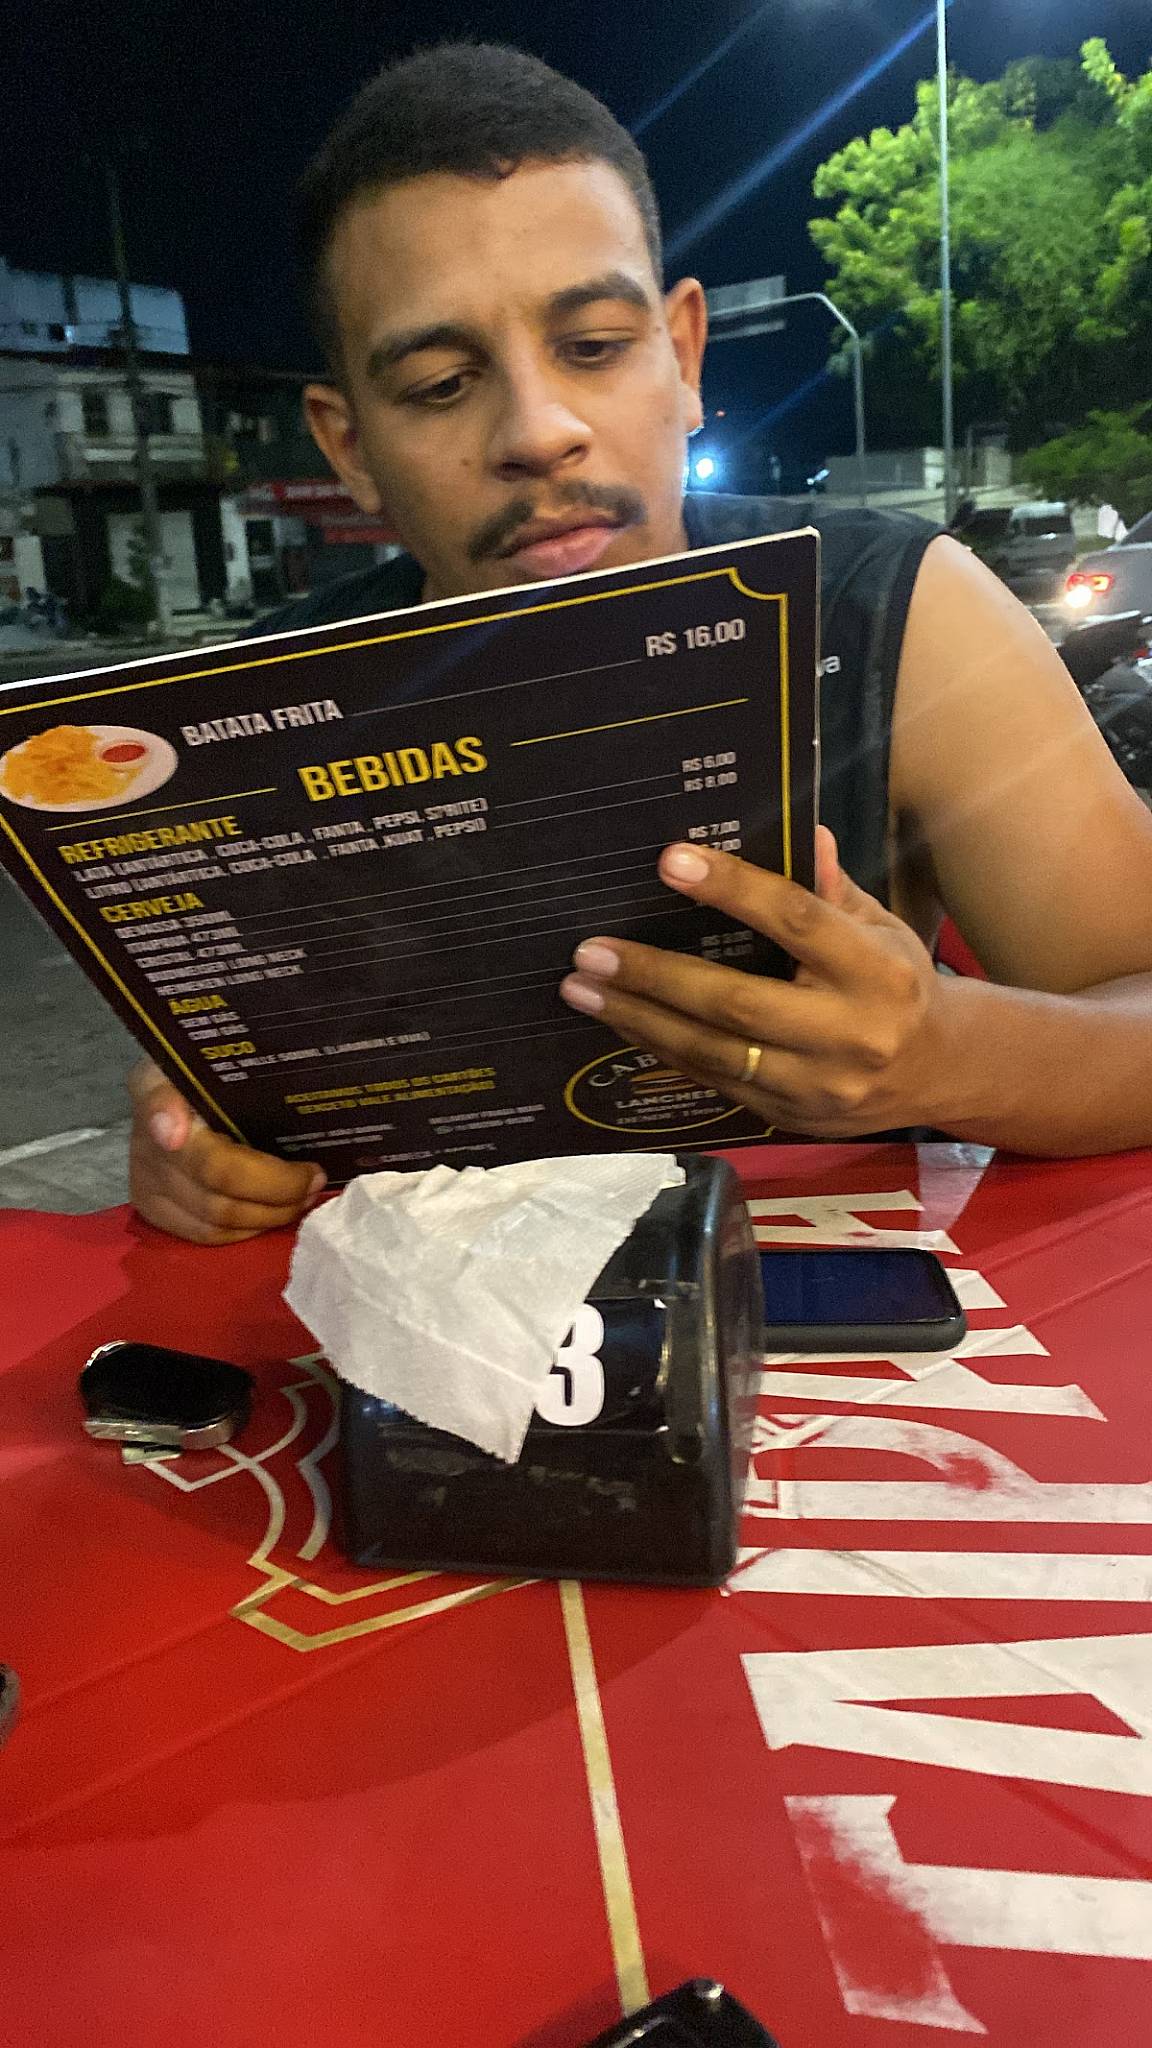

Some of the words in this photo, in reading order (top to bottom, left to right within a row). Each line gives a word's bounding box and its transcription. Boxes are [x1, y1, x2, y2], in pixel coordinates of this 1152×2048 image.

[180, 713, 273, 746] BATATA
[271, 700, 344, 730] FRITA
[683, 618, 746, 649] 16,00
[297, 737, 488, 802] BEBIDAS
[58, 816, 243, 864] REFRIGERANTE
[100, 892, 205, 923] CERVEJA
[200, 1041, 256, 1059] SUCO
[615, 1089, 719, 1109] LANCHES
